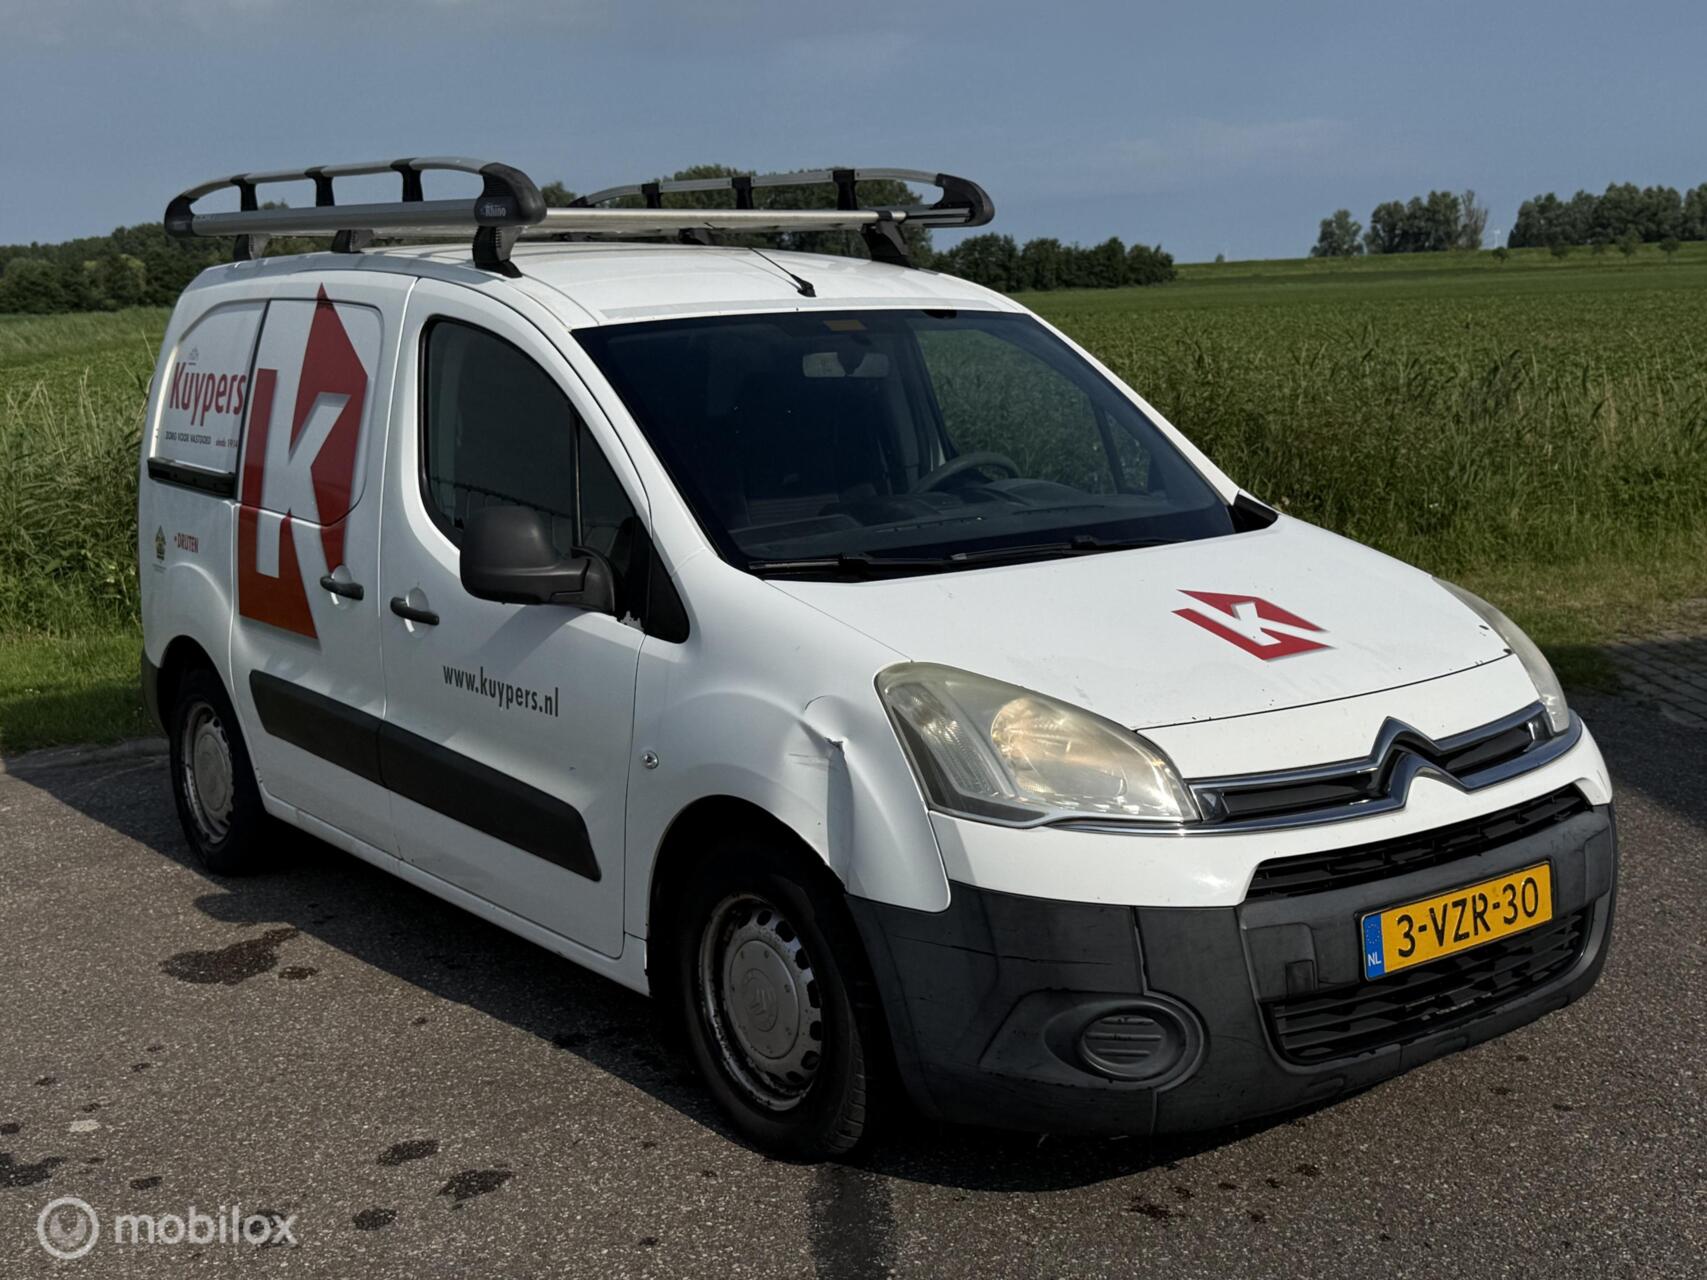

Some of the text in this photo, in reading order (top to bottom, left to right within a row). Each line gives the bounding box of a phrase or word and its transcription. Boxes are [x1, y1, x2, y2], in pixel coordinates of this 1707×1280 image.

[443, 665, 559, 717] www.kuypers.nl
[1396, 877, 1539, 958] 3-VZR-30
[1367, 951, 1382, 967] NL
